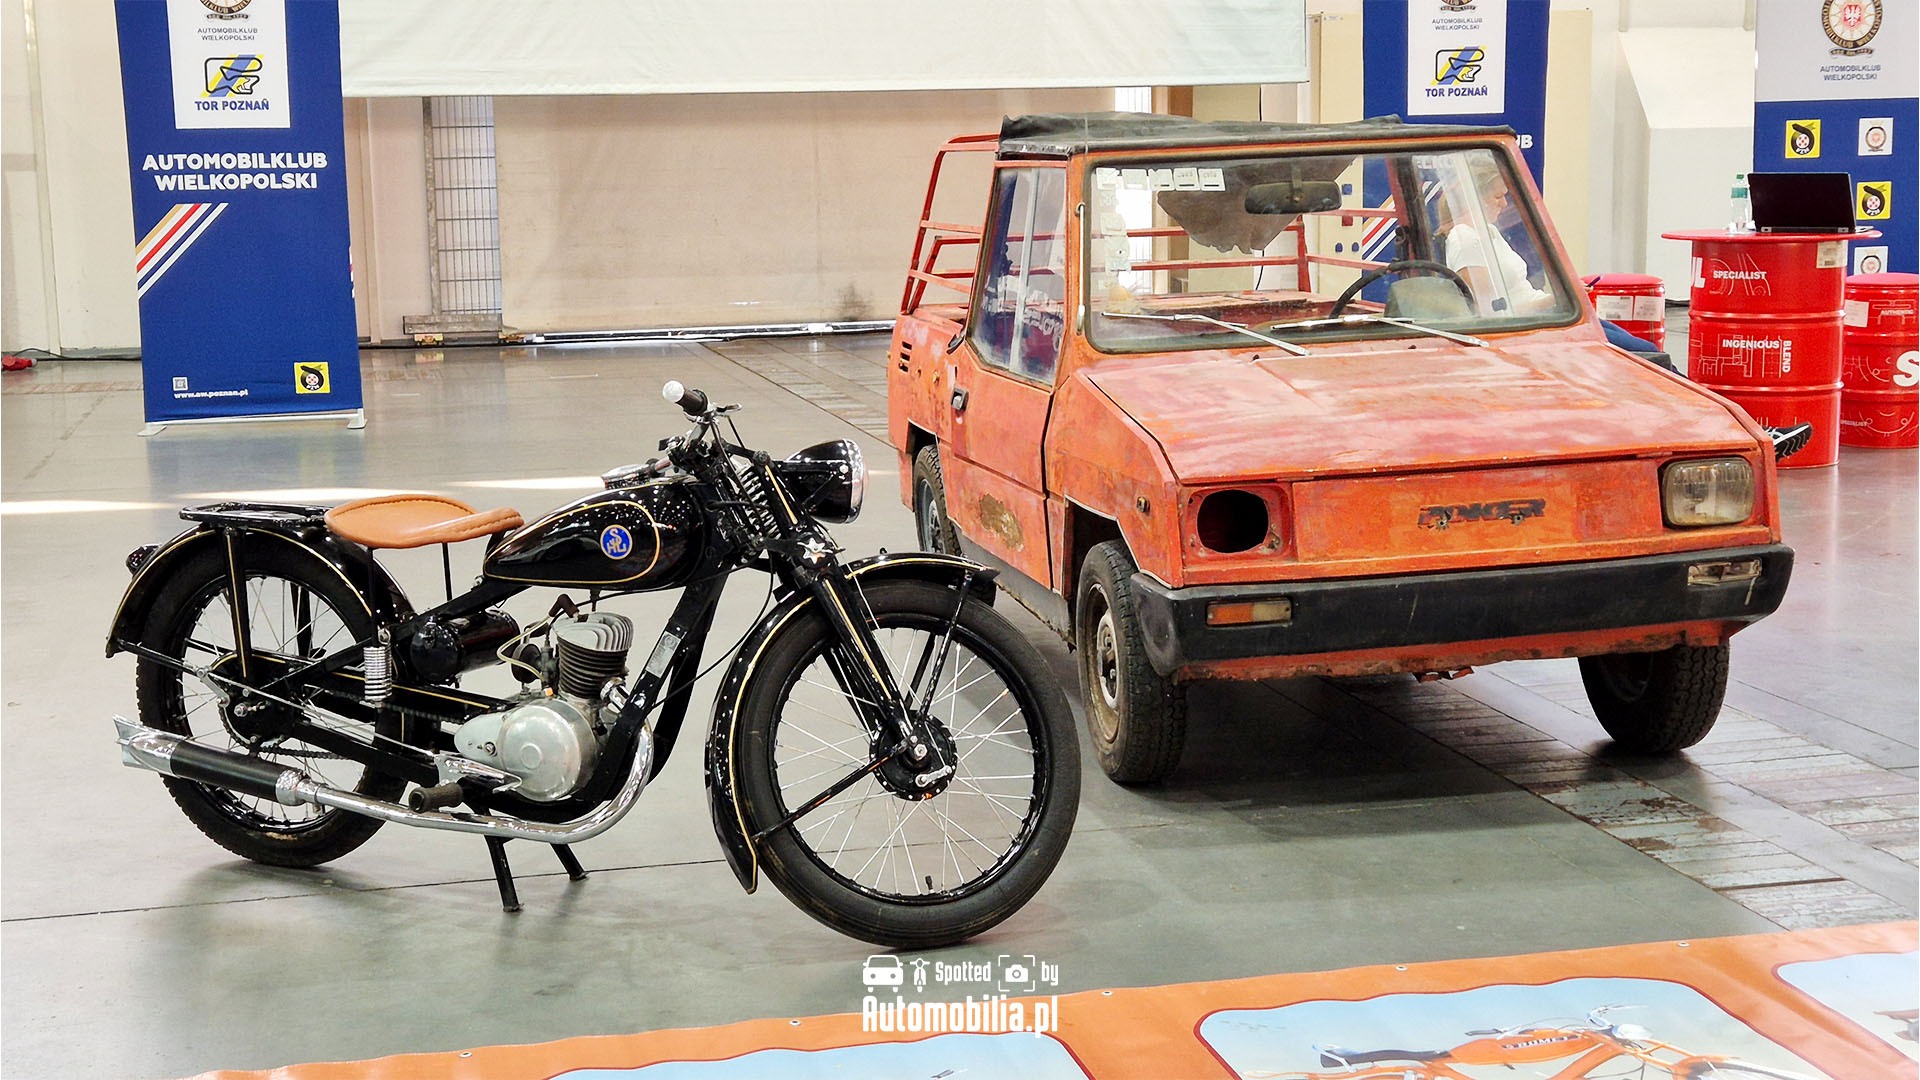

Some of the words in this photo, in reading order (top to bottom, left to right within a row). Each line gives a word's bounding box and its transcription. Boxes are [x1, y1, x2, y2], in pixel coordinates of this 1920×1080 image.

[1425, 88, 1445, 97] TOR
[195, 101, 218, 111] TOR
[142, 153, 328, 170] AUTOMOBILKLUB
[155, 173, 318, 191] WIELKOPOLSKI
[1713, 270, 1767, 280] SPECIALIST
[1722, 339, 1780, 349] INGENIOUS
[1782, 340, 1792, 373] BLEND
[174, 389, 249, 399] www.aw.poznan.pl
